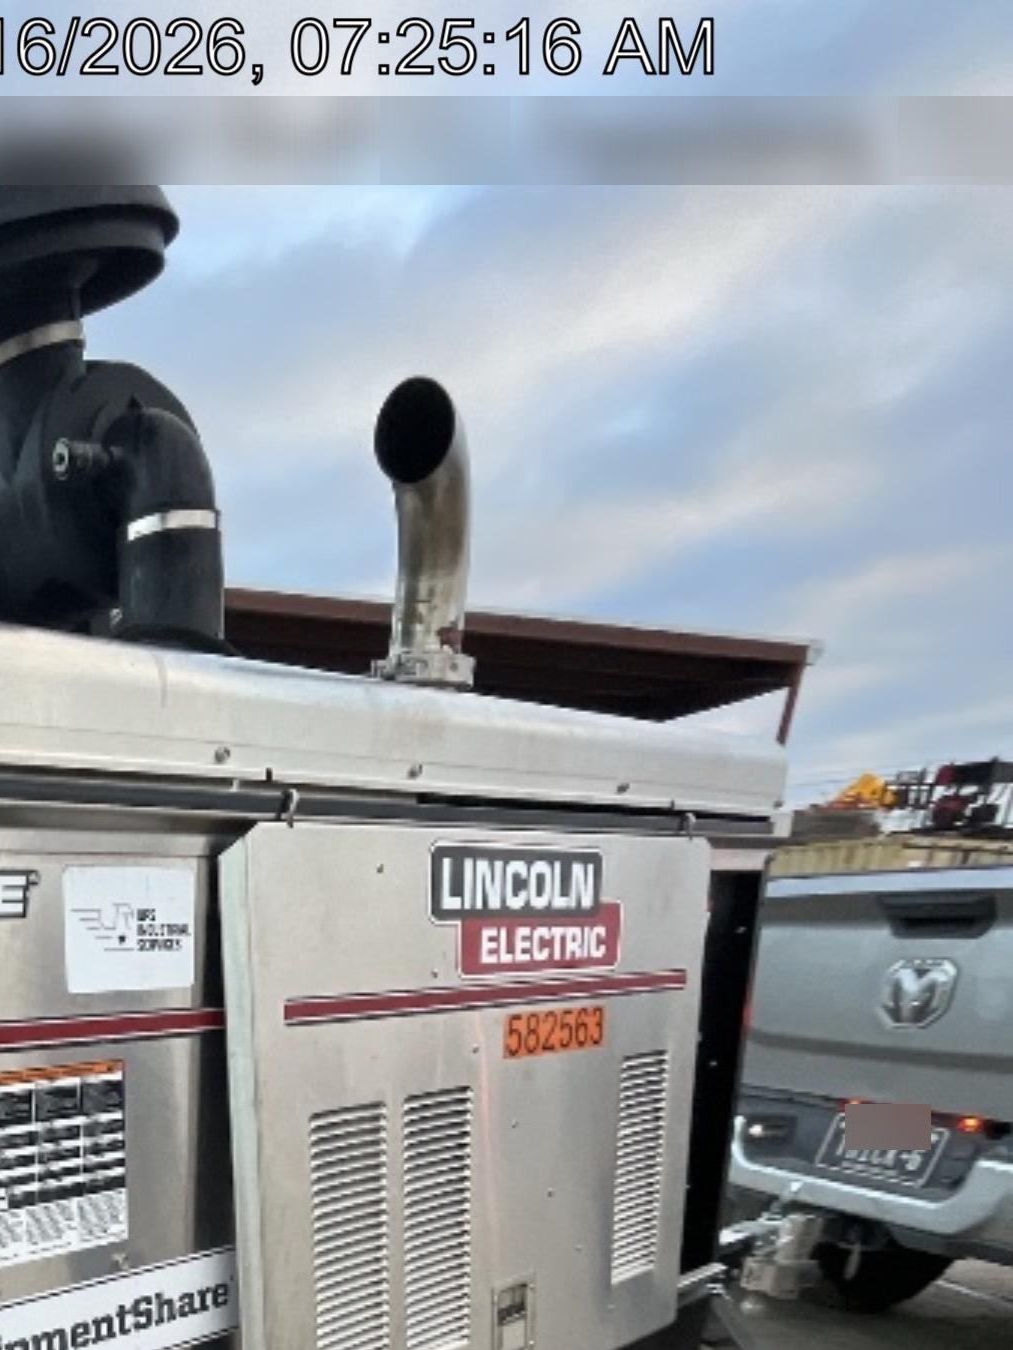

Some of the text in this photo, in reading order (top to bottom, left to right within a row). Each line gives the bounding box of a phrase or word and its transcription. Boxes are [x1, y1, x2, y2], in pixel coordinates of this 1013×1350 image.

[441, 857, 595, 911] LINCOLN
[479, 926, 607, 964] ELECTRIC
[505, 1007, 604, 1057] 582563
